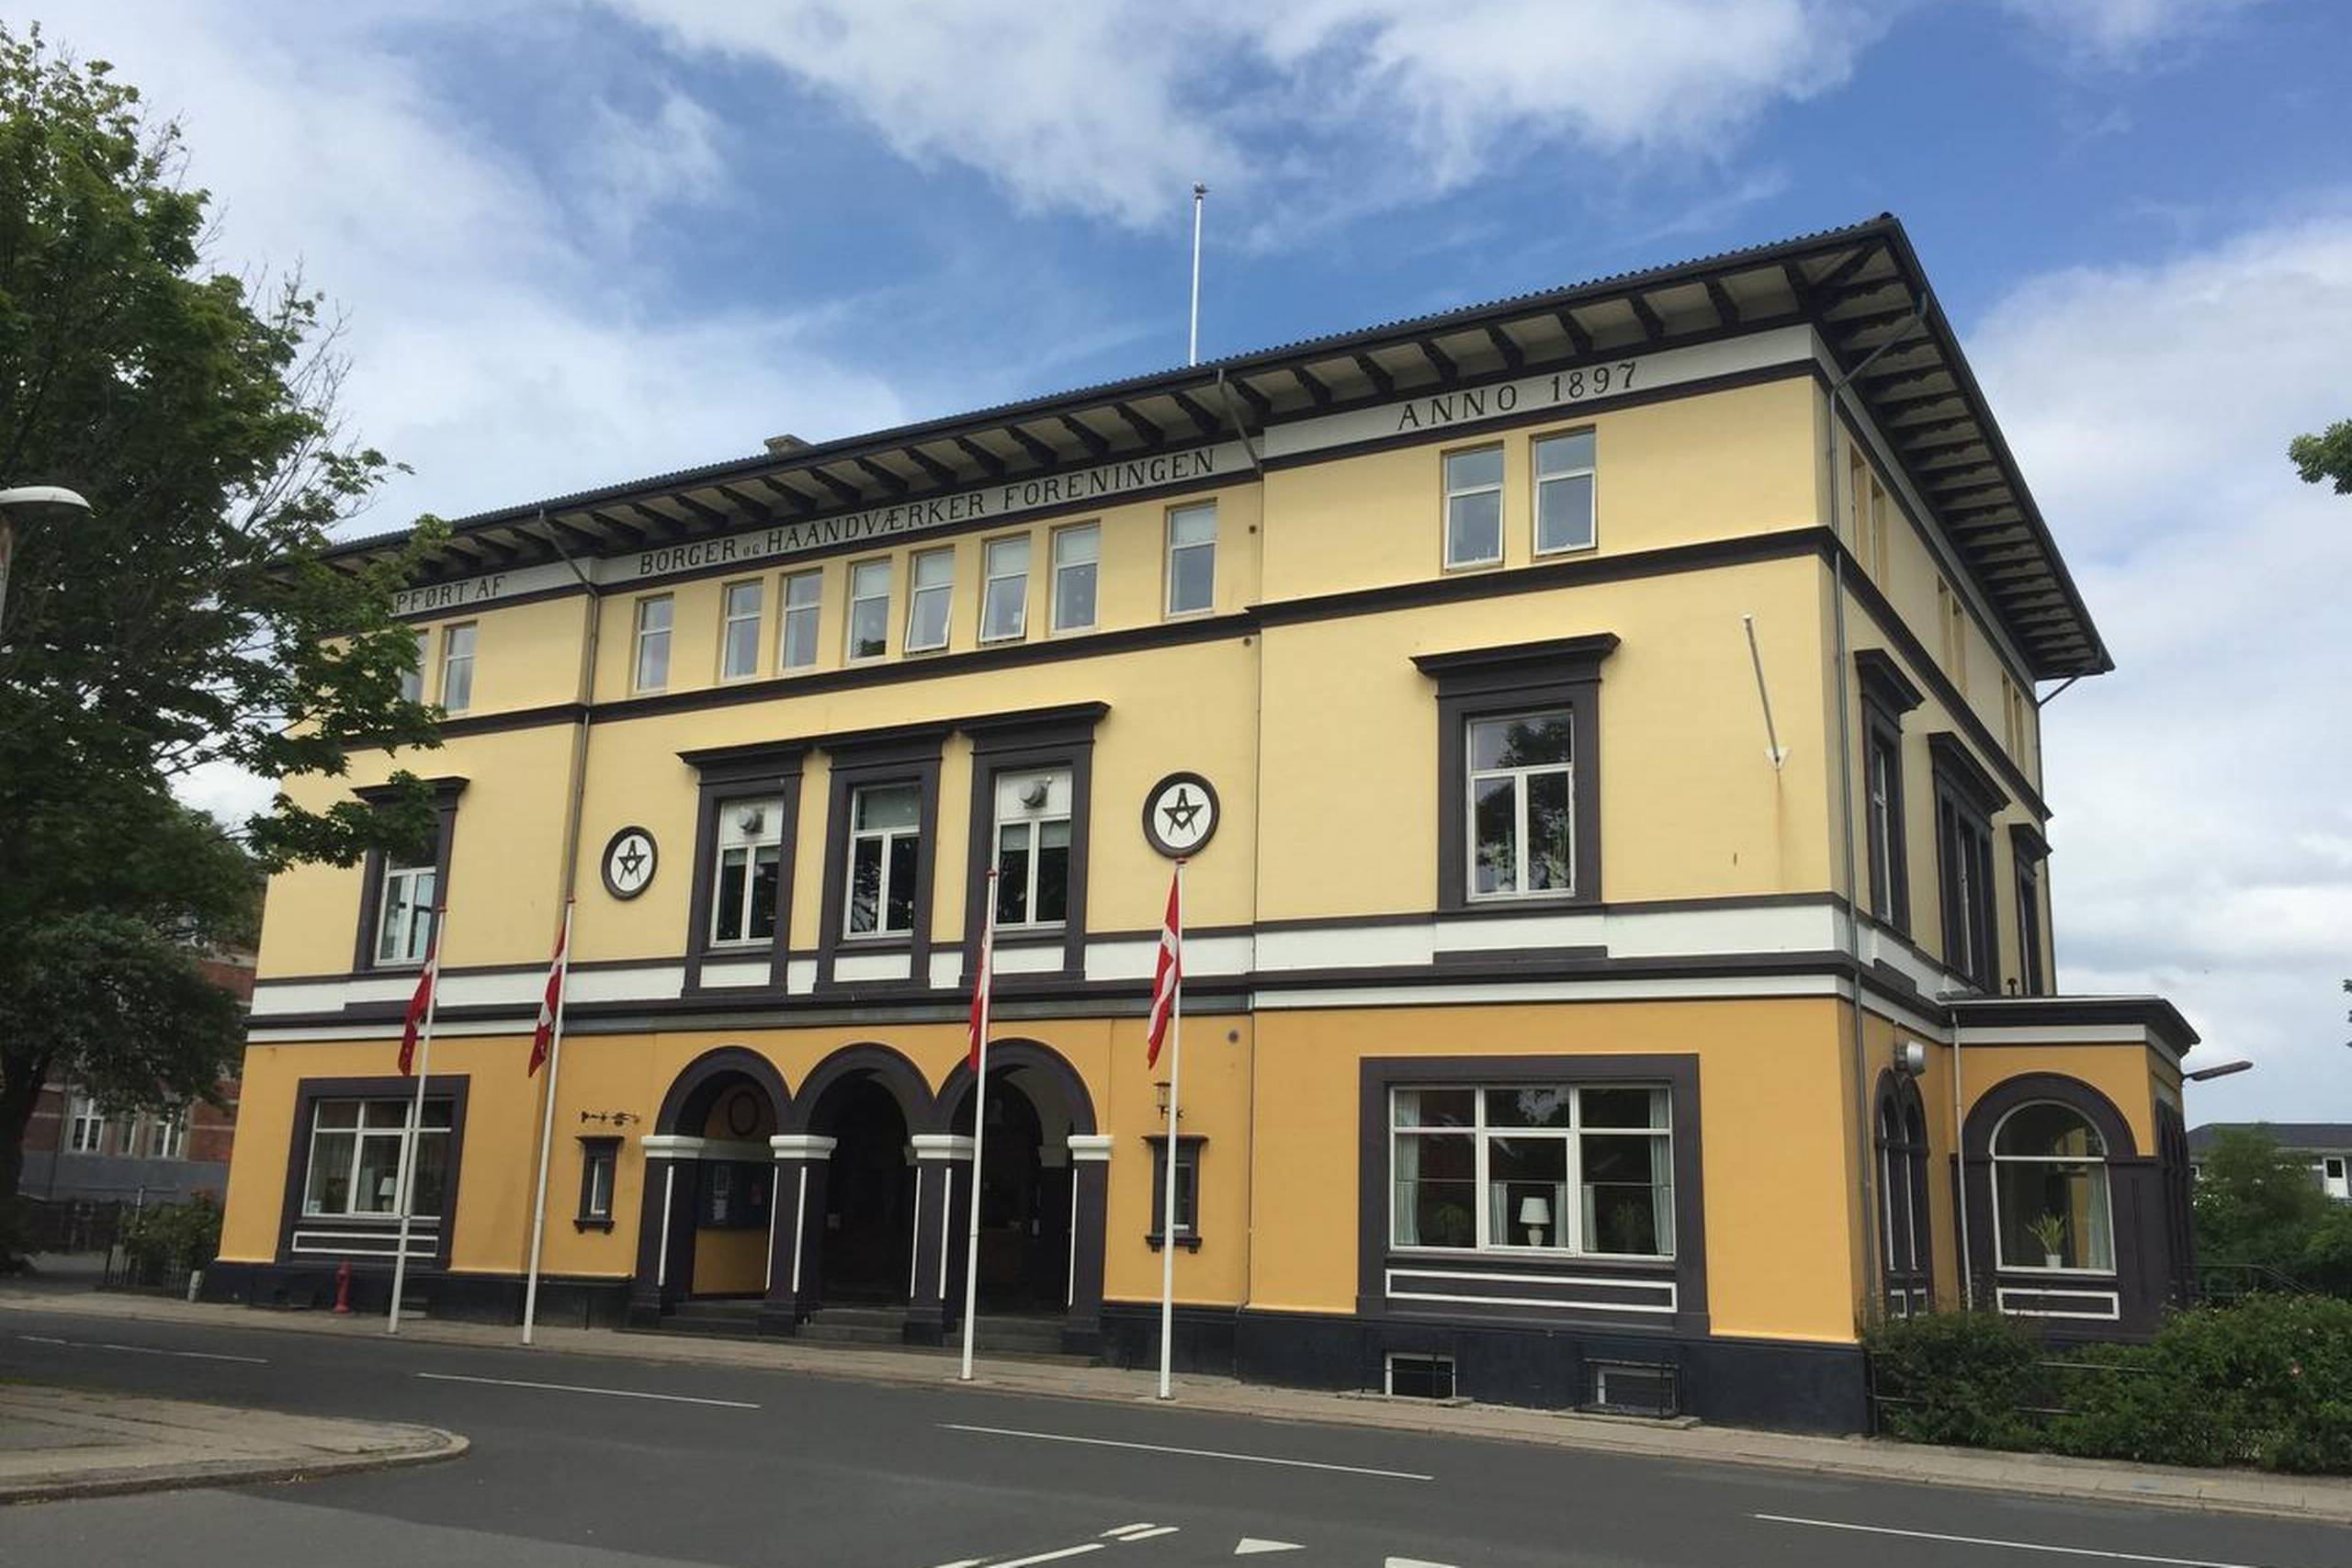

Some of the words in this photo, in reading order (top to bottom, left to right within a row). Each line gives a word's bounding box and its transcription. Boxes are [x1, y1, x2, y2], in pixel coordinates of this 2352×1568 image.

[1396, 385, 1518, 432] ANNO
[1550, 360, 1638, 402] 1897
[639, 538, 738, 576] BORGER
[765, 493, 986, 554] HAANDVÆRKER
[1002, 447, 1216, 511] FORENINGEN
[395, 581, 469, 614] PFØRT
[475, 575, 507, 599] AF
